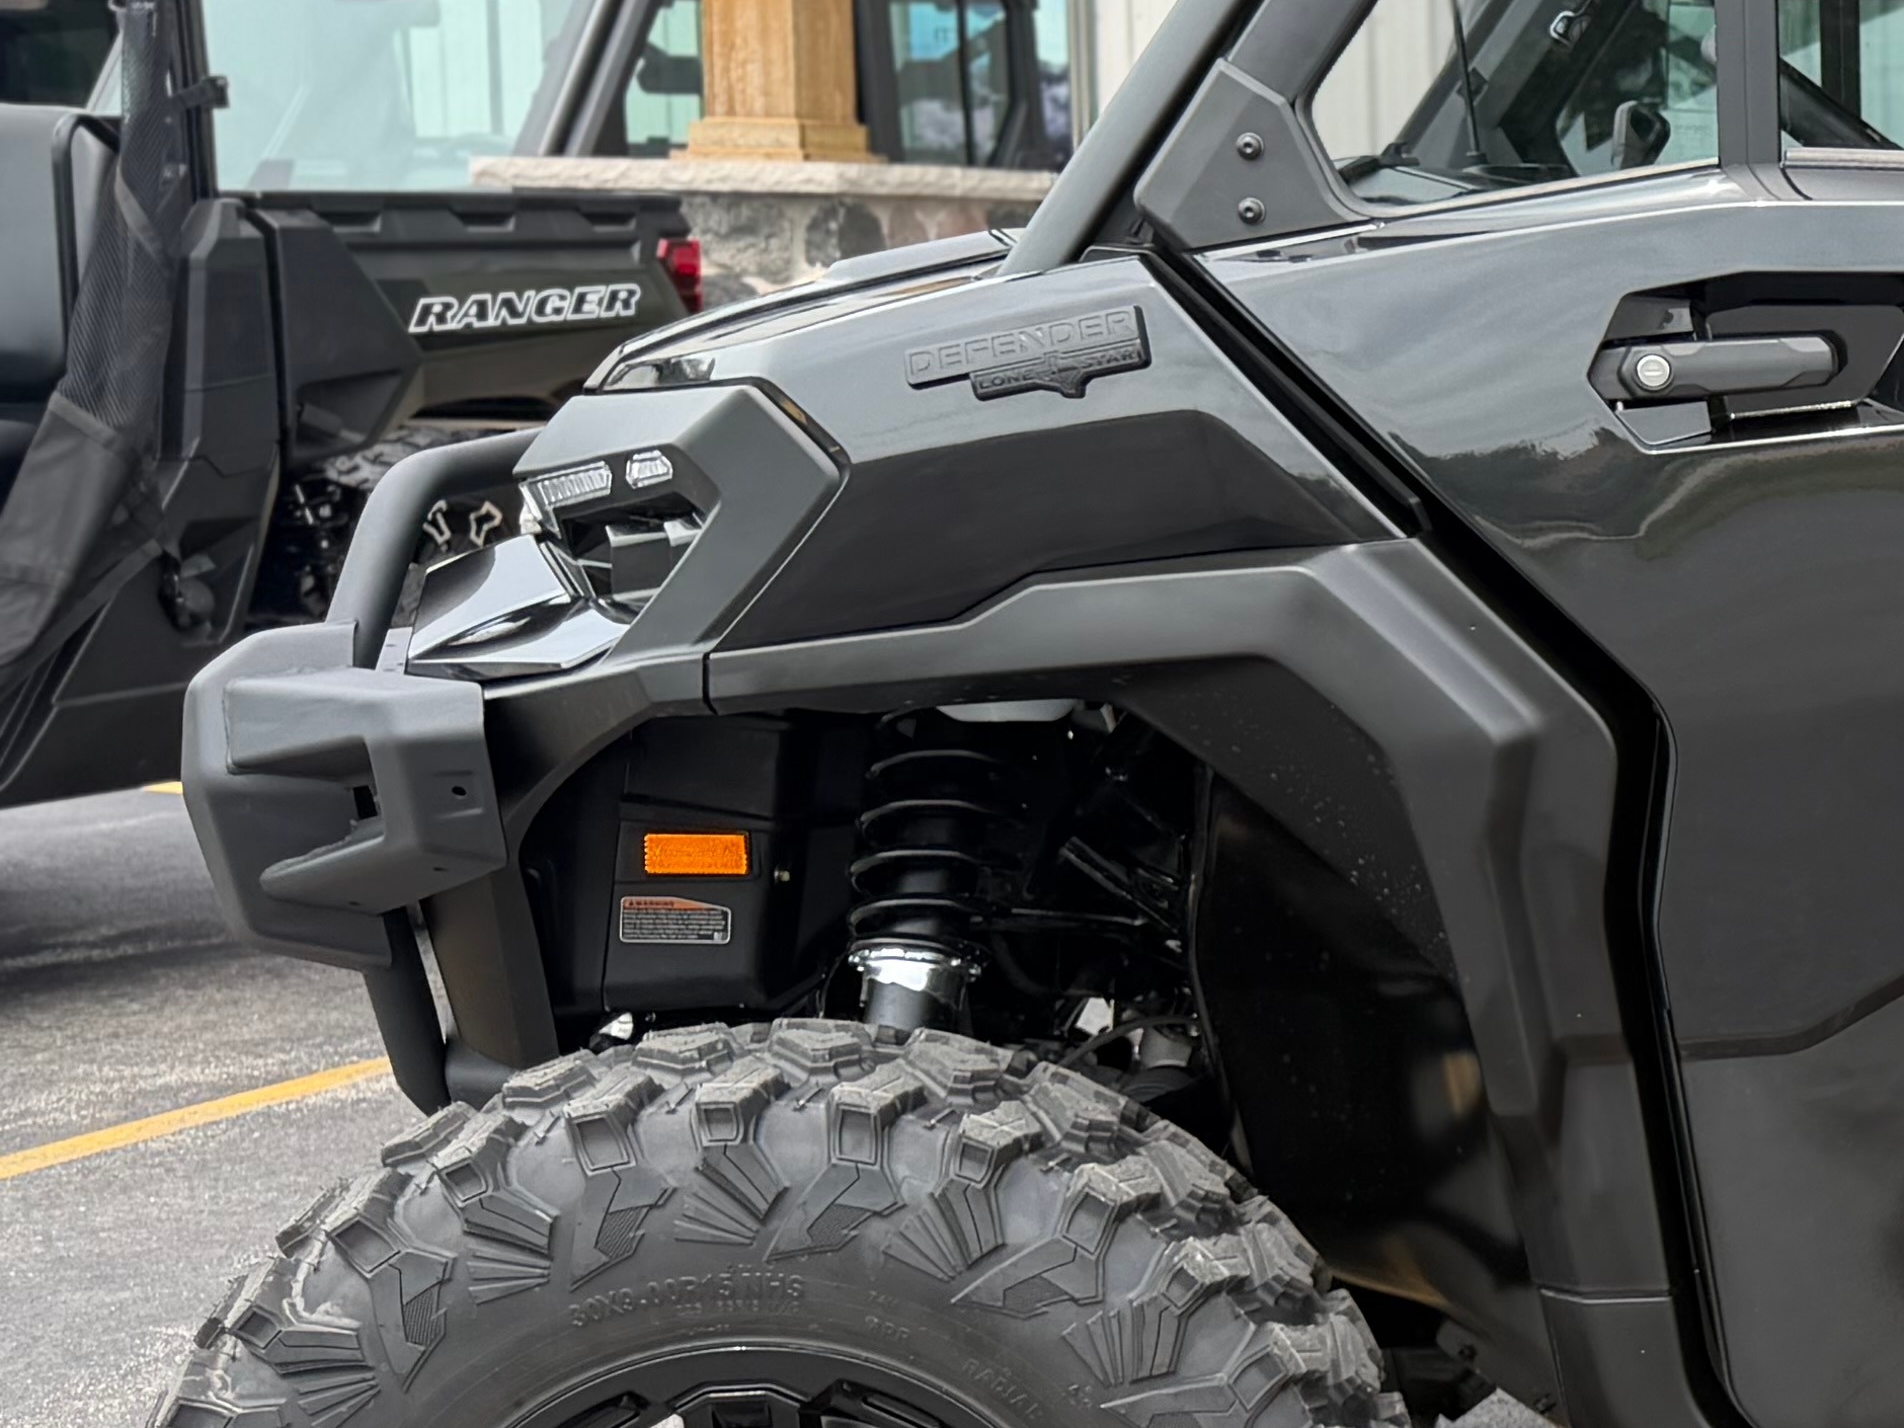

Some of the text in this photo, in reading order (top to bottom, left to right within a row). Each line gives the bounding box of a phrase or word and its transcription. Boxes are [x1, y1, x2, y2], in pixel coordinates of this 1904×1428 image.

[409, 283, 641, 333] RANGER
[907, 309, 1137, 375] DEFENDER
[1083, 350, 1136, 370] STAR
[978, 368, 1037, 390] LONE
